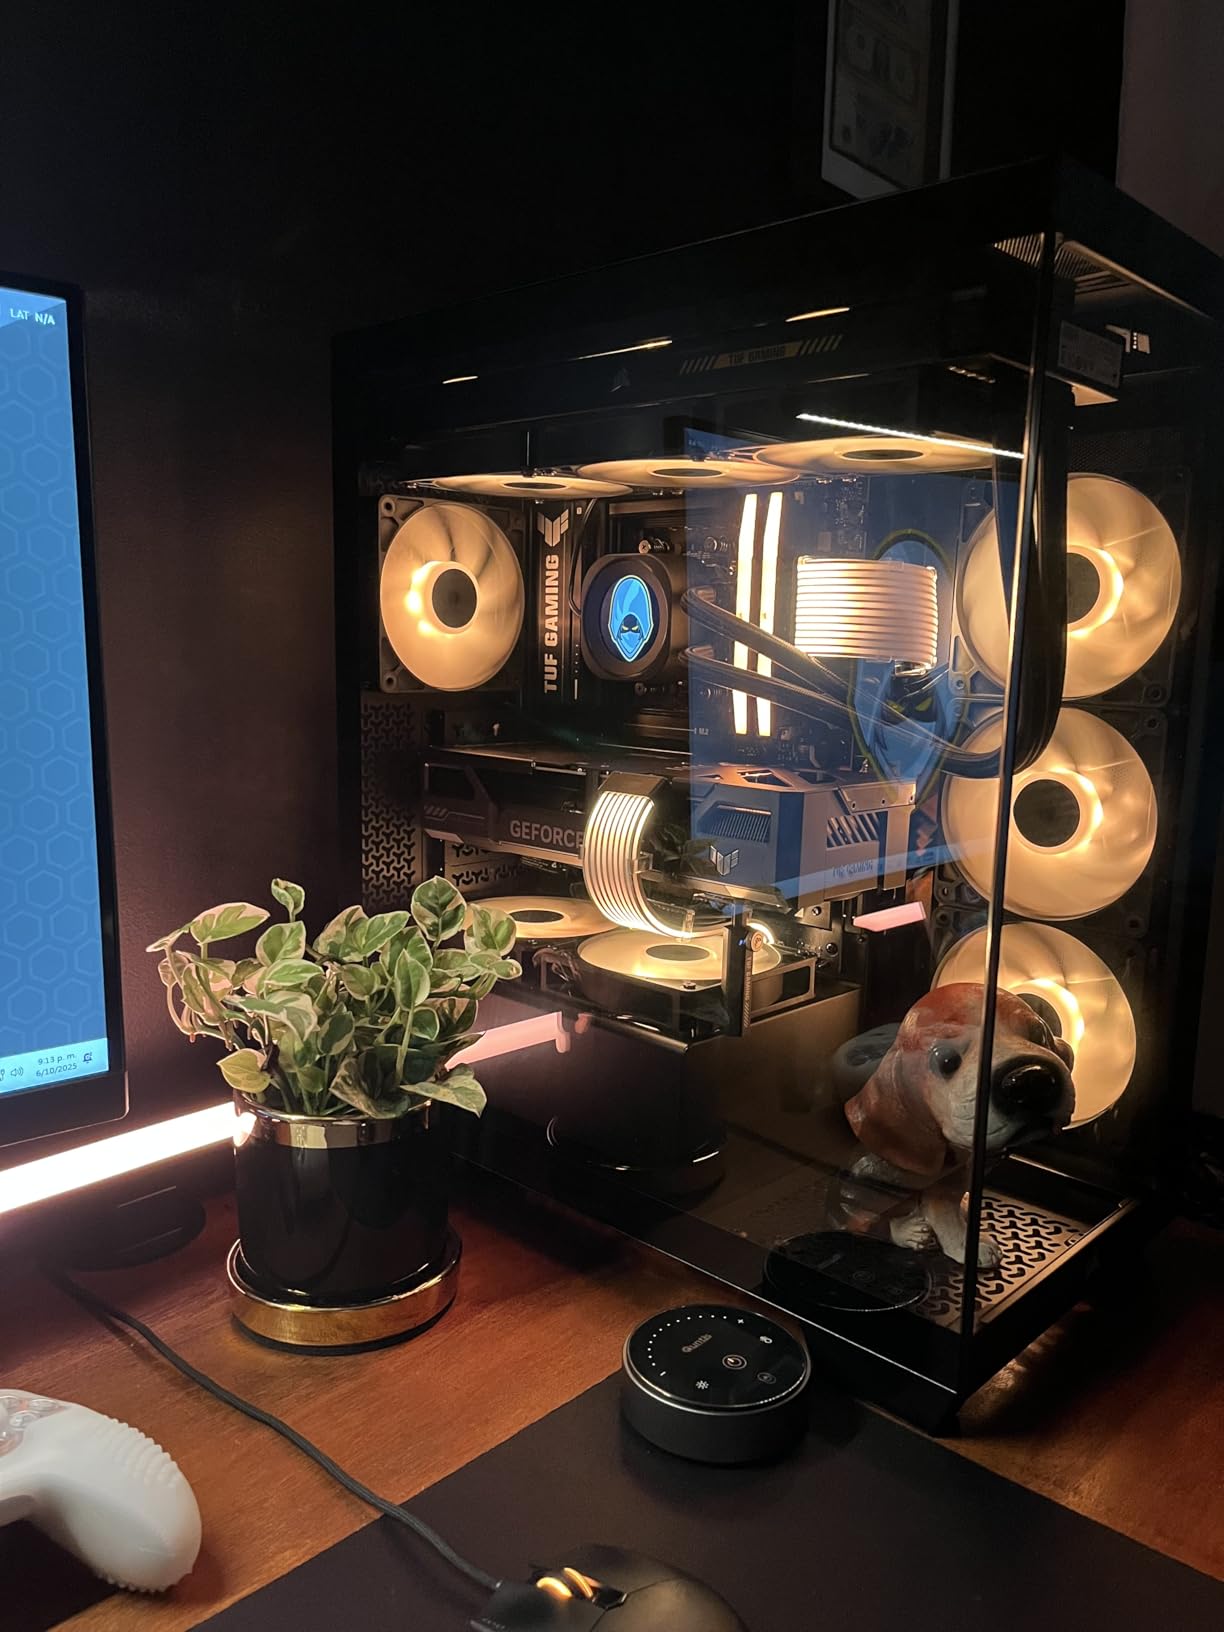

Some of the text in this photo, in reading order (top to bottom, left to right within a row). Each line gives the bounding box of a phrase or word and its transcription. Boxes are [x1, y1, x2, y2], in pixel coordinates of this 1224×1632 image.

[10, 308, 55, 325] LAT N/A
[544, 554, 560, 694] TUF GAMING
[36, 1062, 77, 1077] 6/10/2025
